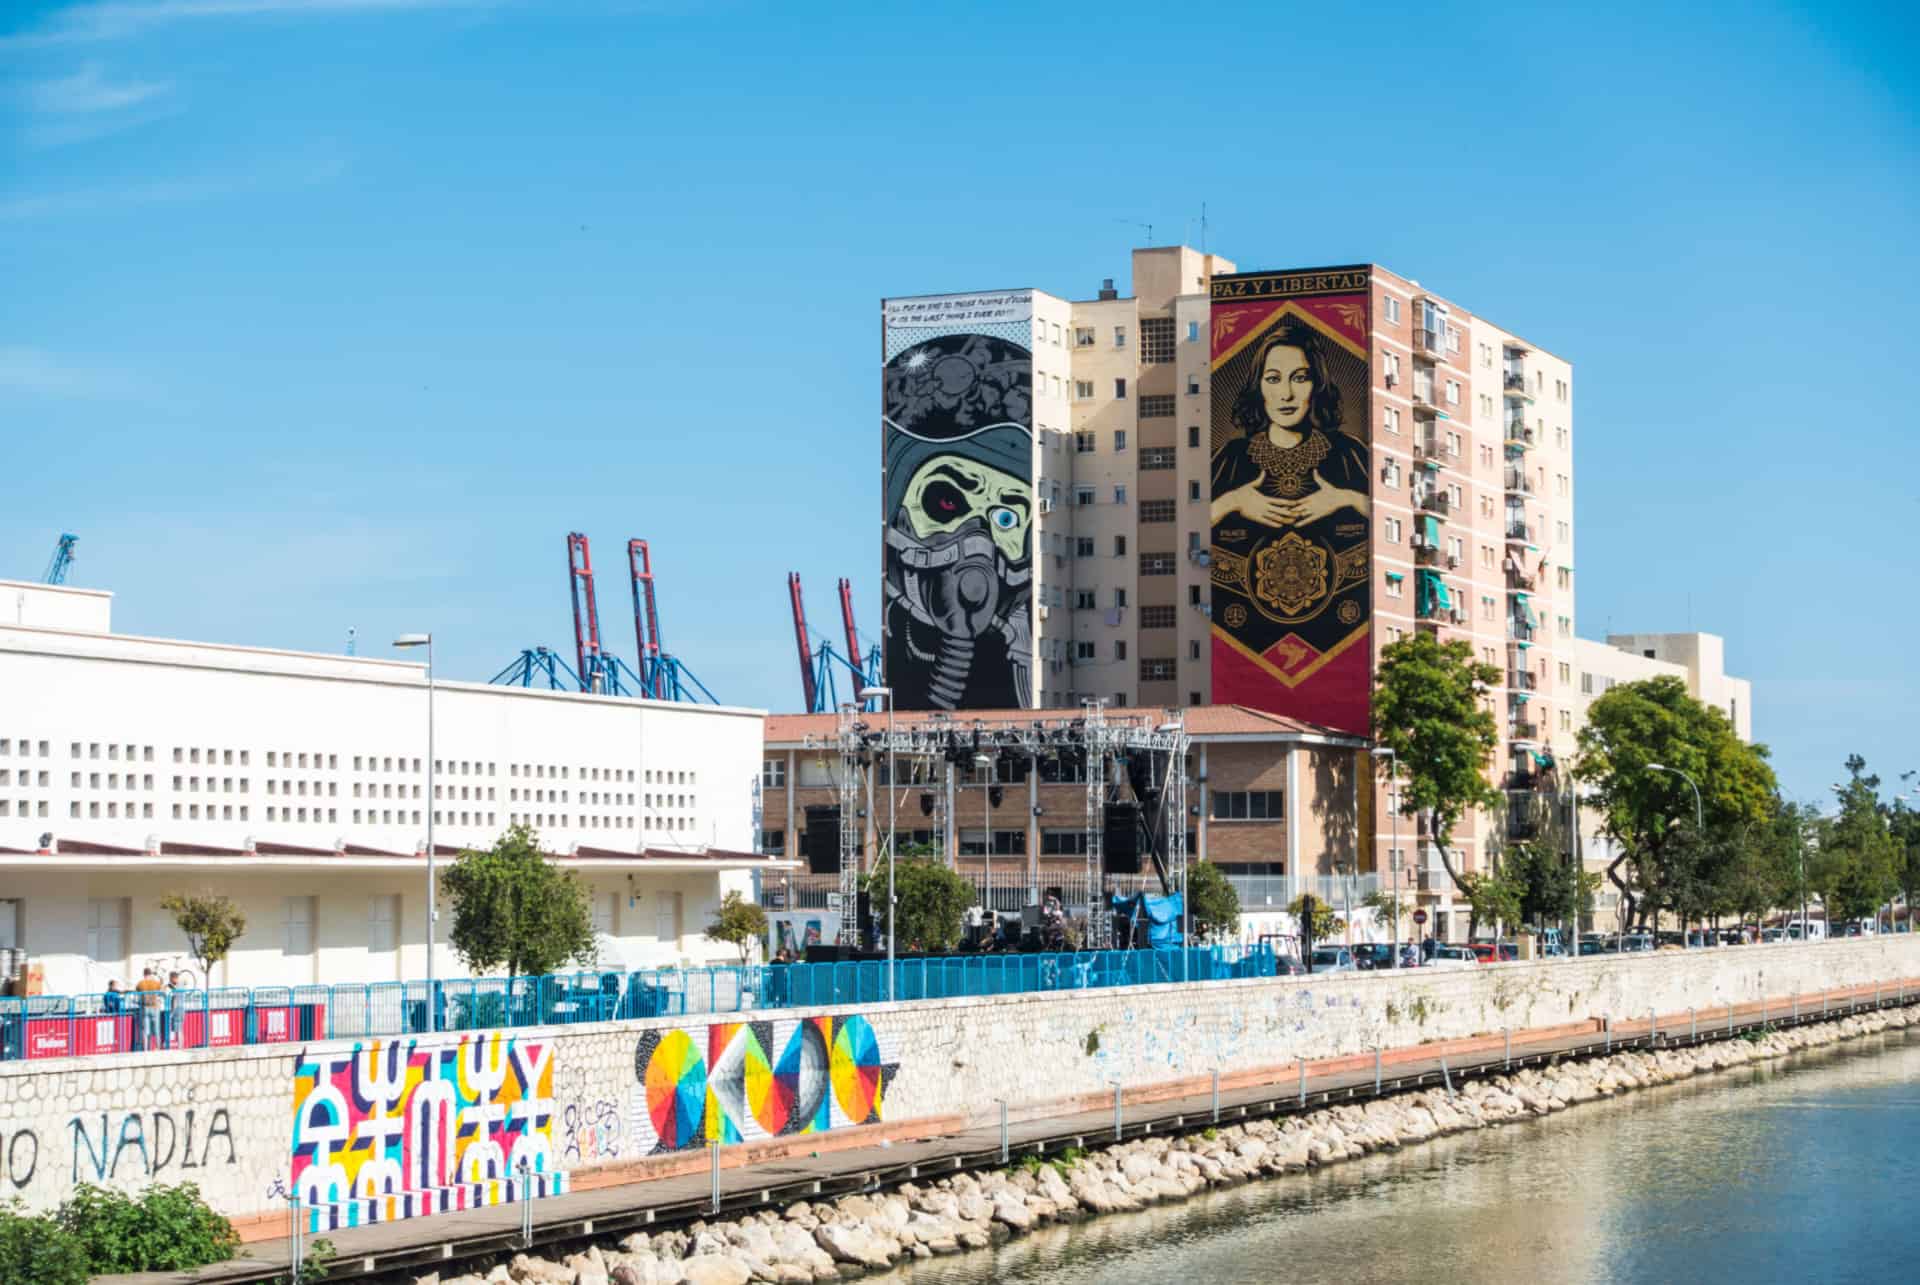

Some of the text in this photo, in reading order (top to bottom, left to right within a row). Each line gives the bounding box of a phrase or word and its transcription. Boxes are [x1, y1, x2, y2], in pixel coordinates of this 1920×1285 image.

[1212, 272, 1367, 297] PAZ Y LIBERTAD
[67, 1106, 236, 1184] NADIA
